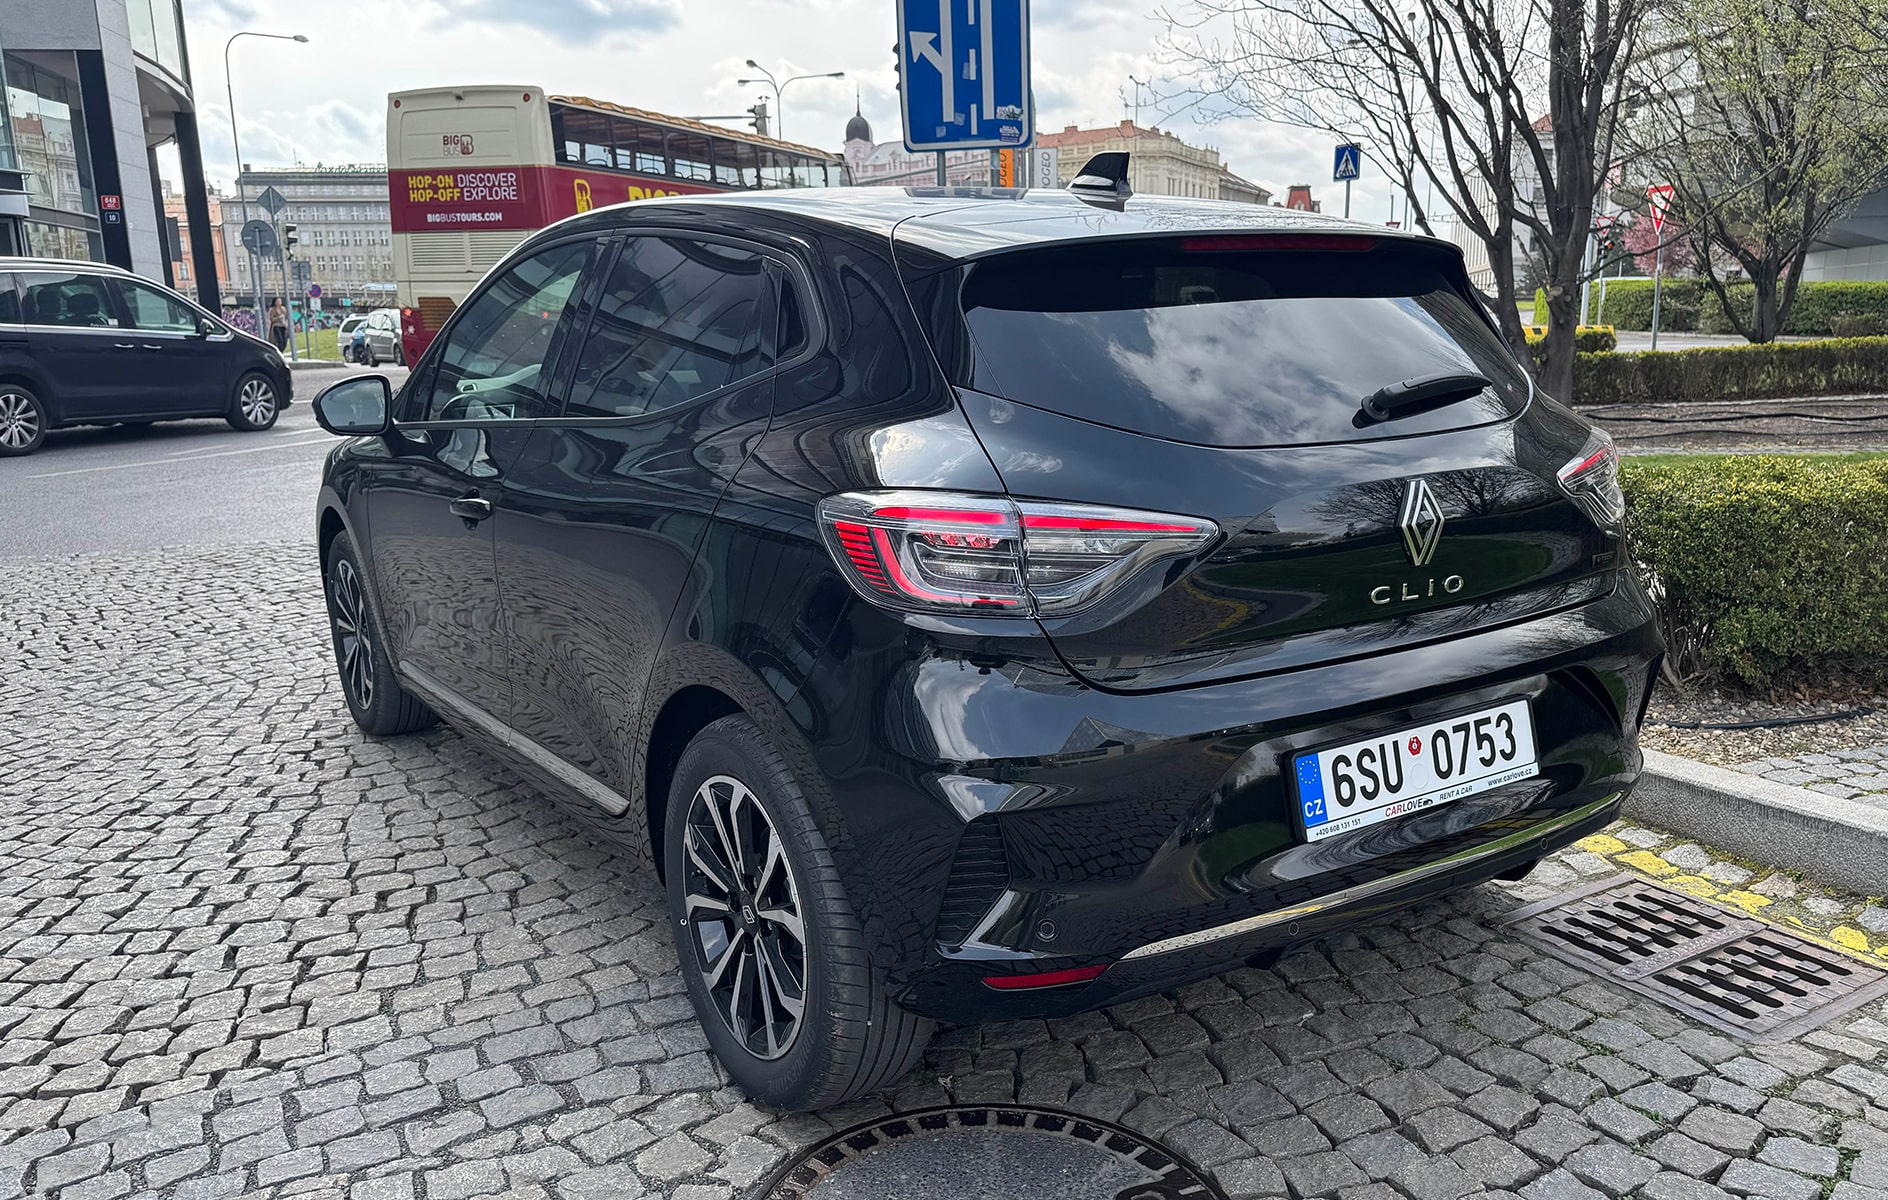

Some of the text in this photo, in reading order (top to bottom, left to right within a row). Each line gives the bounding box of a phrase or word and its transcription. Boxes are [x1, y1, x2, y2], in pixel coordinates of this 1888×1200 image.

[442, 135, 460, 146] BIG
[443, 146, 461, 157] BUS
[1041, 151, 1051, 188] OGEO
[408, 172, 517, 188] HOP-ON DISCOVER
[409, 186, 518, 202] HOP-OFF EXPLORE
[109, 214, 116, 222] 10
[426, 212, 503, 223] BIGBUSTOURS.COM
[1369, 574, 1464, 605] CLIO
[1331, 712, 1517, 808] 6SU 0753
[1487, 767, 1533, 787] www.carlove.cz
[1439, 789, 1456, 801] RENT
[1460, 785, 1473, 796] CAR
[1304, 798, 1324, 818] CZ
[1385, 797, 1423, 818] CARLOVE
[1316, 818, 1361, 836] +420 608 131 151
